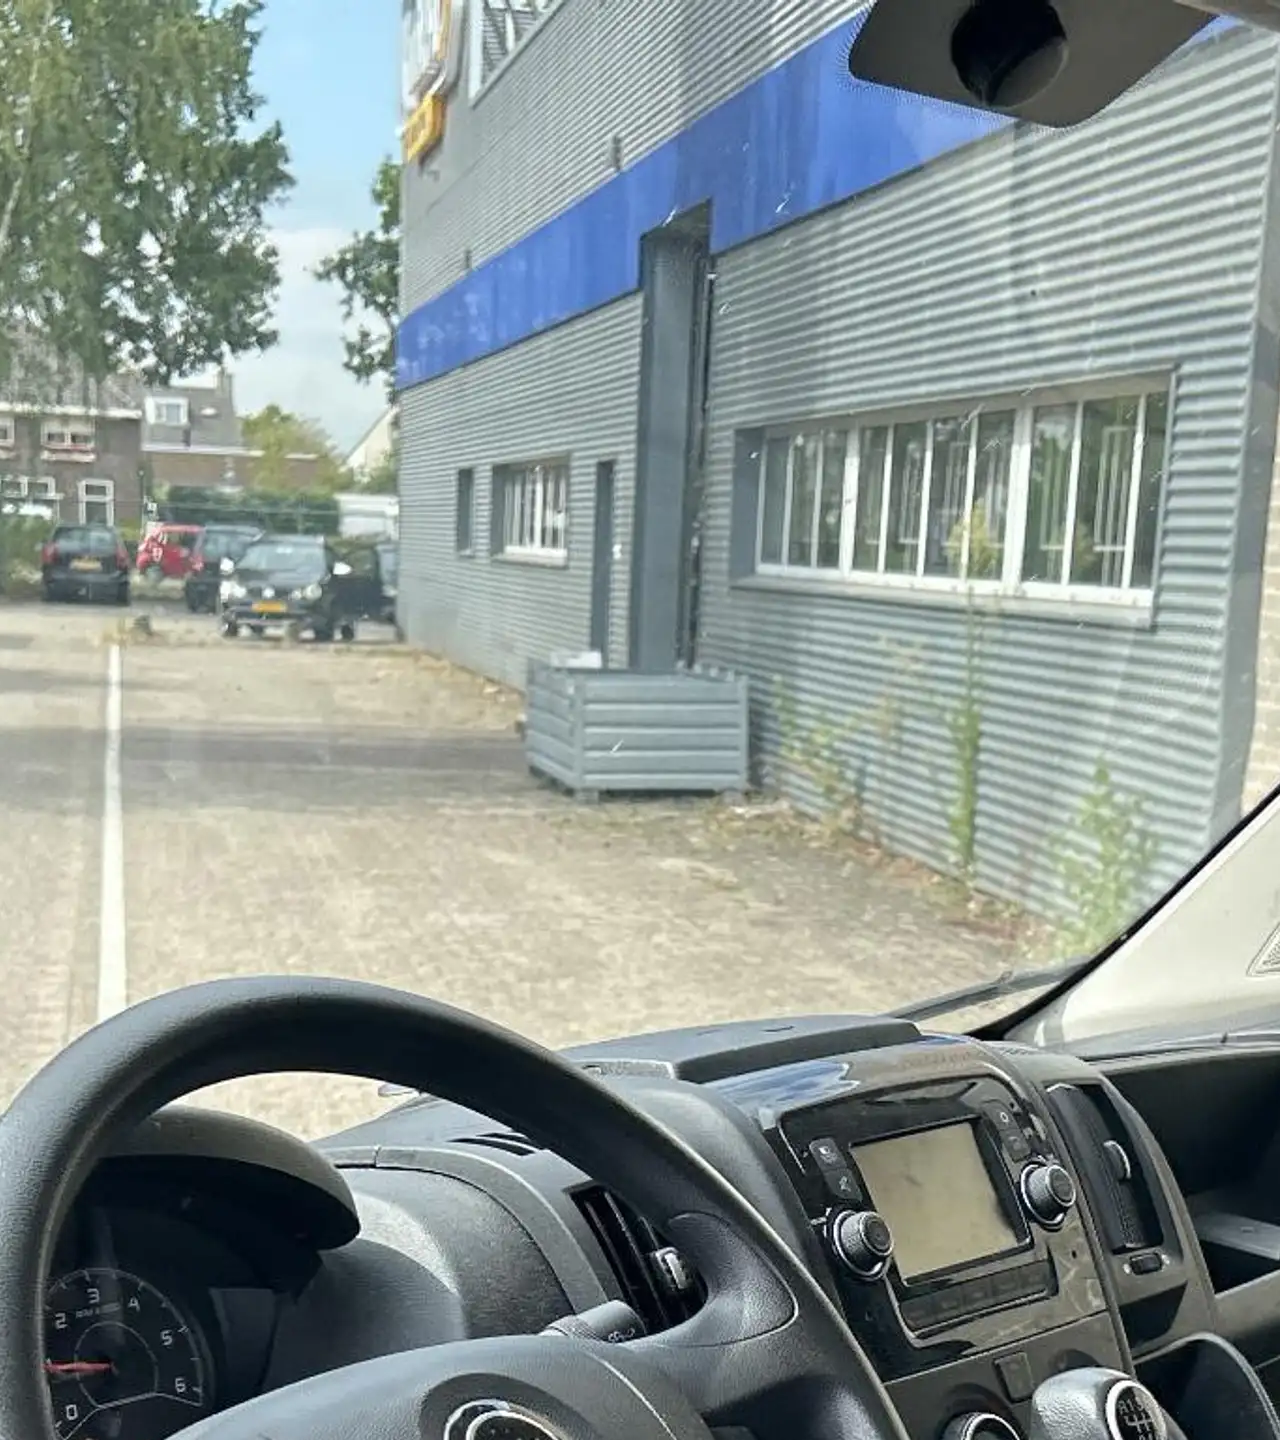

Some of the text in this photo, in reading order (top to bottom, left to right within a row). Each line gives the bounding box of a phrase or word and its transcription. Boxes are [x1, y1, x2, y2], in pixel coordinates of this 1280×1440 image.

[87, 1288, 99, 1303] 3
[128, 1298, 140, 1311] 4
[55, 1313, 67, 1328] 2
[161, 1330, 173, 1346] 5
[174, 1377, 186, 1393] 6
[65, 1404, 78, 1421] 0
